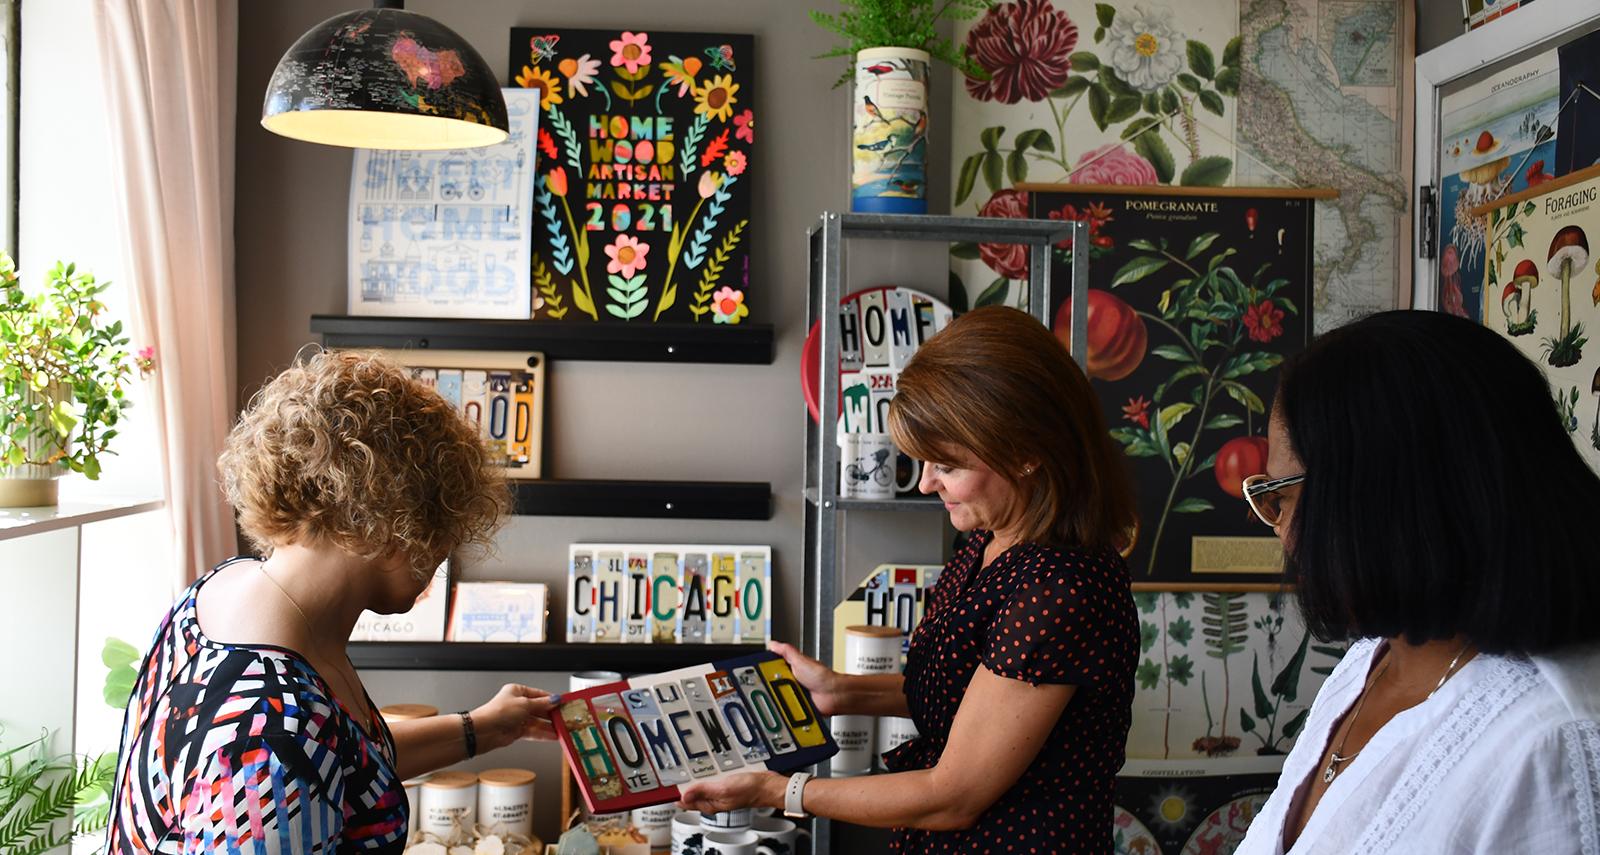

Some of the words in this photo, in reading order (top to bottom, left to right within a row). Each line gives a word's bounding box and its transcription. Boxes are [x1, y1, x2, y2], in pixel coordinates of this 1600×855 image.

[1491, 69, 1540, 93] OCEANOGRAPHY
[589, 114, 674, 140] HOME
[589, 138, 675, 164] WOOD
[364, 158, 520, 190] SWEET
[588, 163, 675, 181] ARTISAN
[586, 182, 675, 201] MARKET
[585, 202, 673, 232] 2021
[1125, 200, 1219, 213] POMEGRANATE
[363, 206, 516, 241] HOME
[360, 262, 515, 296] WOOD
[574, 573, 763, 623] CHICAGO
[357, 622, 414, 633] HICAGO
[572, 678, 813, 780] HOMEWOOD
